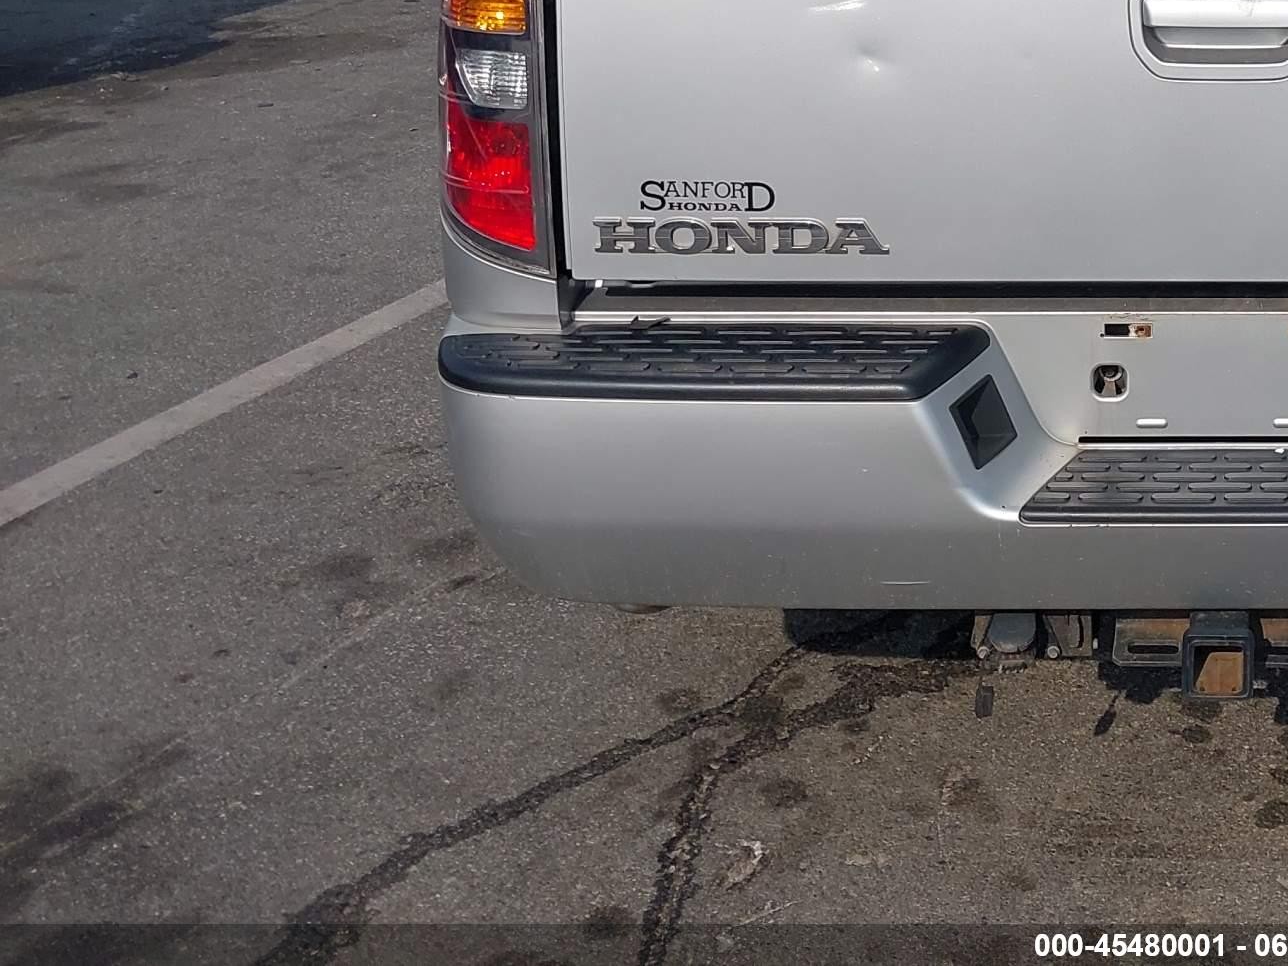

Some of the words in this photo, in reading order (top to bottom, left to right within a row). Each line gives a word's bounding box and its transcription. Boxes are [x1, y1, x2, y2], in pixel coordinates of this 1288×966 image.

[640, 180, 775, 212] SANFORD
[667, 202, 740, 212] HONDA
[592, 217, 890, 255] HONDA
